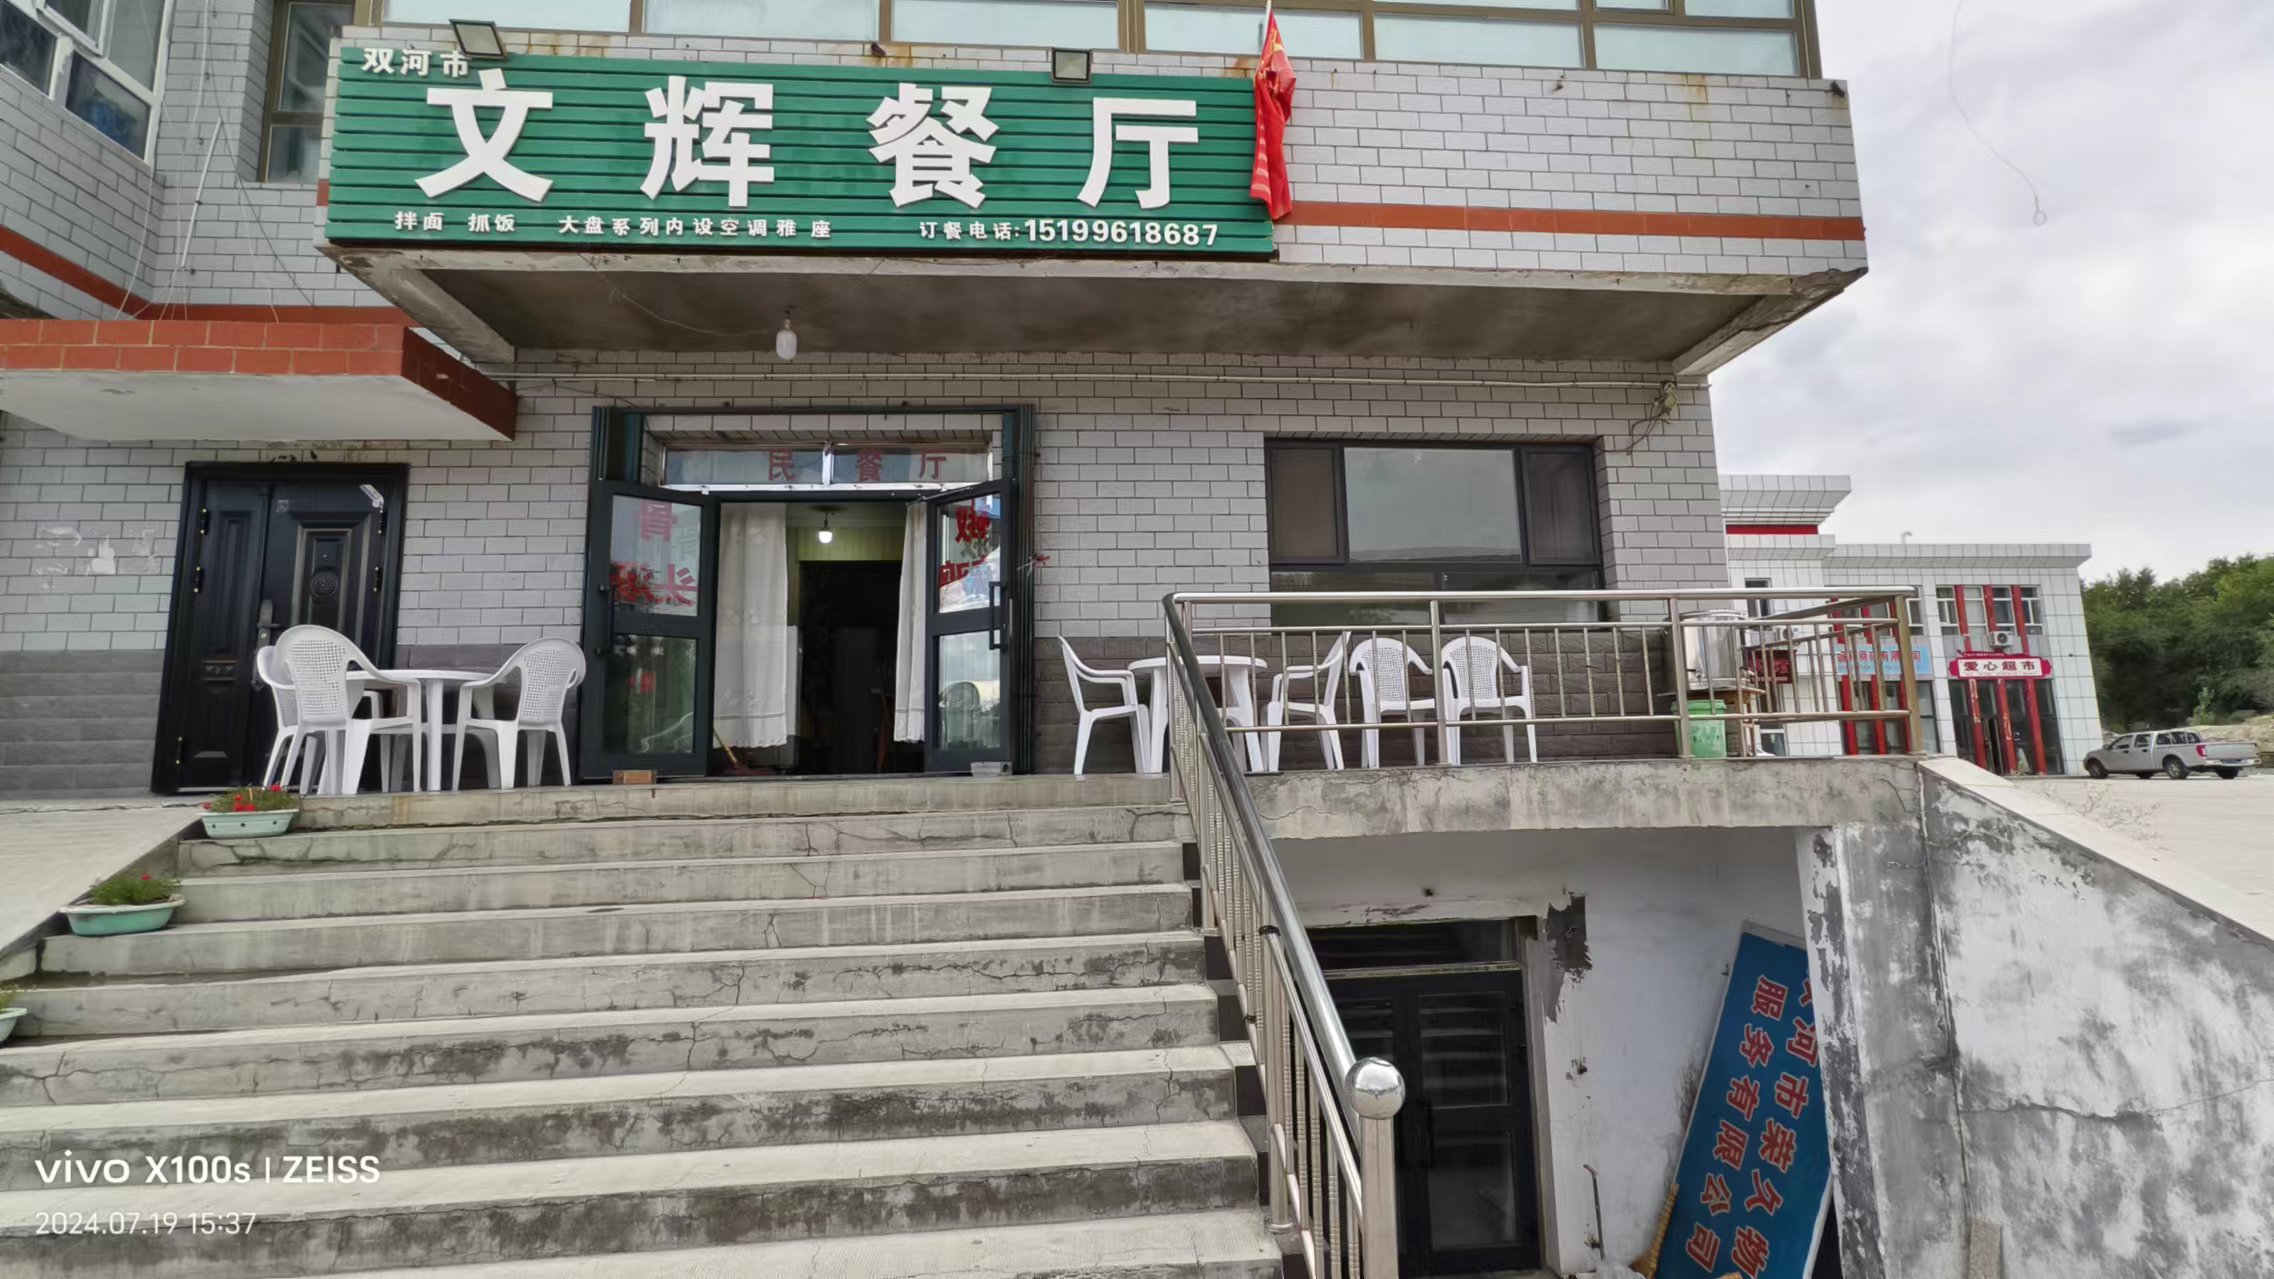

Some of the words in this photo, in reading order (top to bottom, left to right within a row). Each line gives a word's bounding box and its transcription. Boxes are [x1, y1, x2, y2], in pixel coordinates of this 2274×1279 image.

[361, 47, 472, 78] 双河市
[415, 68, 1199, 209] 文辉餐厅
[394, 211, 444, 231] 拌面
[468, 213, 516, 233] 抓饭
[558, 216, 832, 238] 大盘系列内设空调雅座
[1963, 661, 2036, 672] 爱心超市
[1685, 974, 1788, 1272] 服务有限公司
